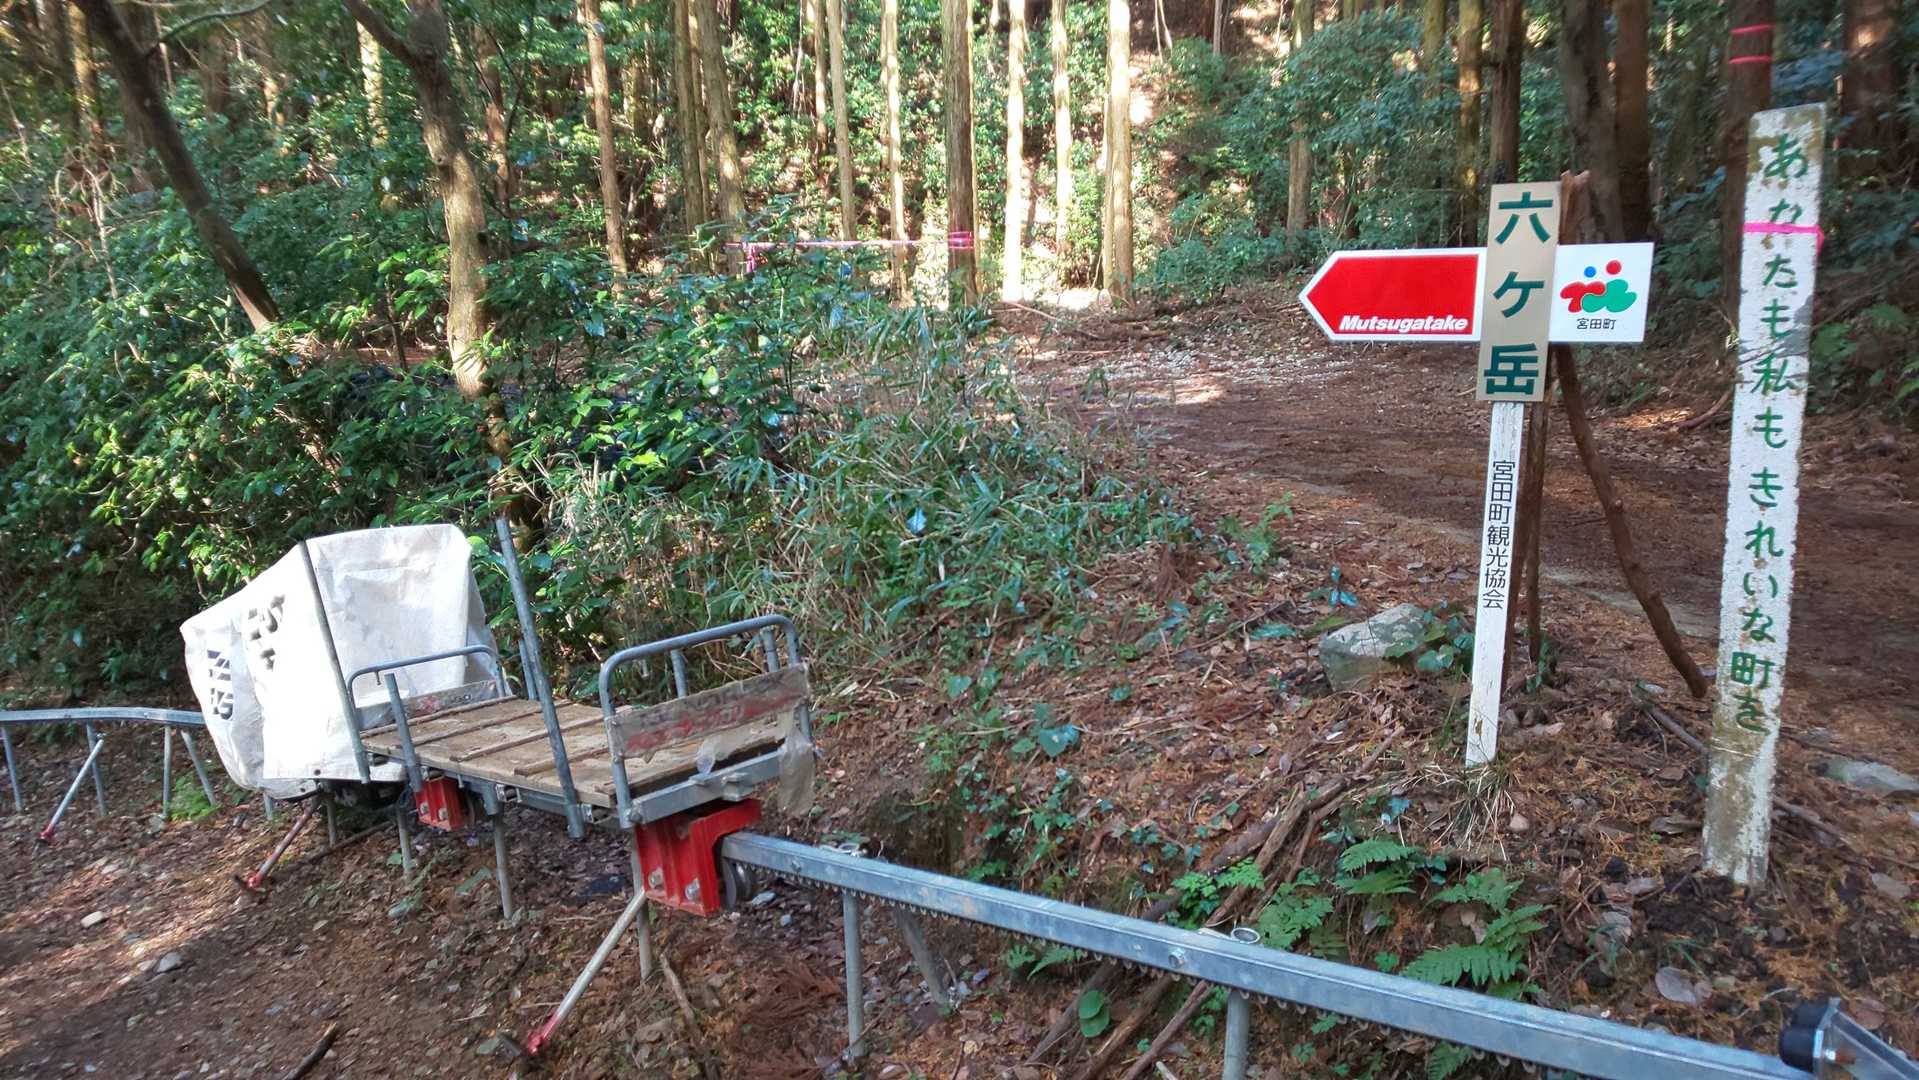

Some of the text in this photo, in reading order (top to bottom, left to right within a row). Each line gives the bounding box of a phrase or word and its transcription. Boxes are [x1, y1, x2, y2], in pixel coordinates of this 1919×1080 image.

[1339, 314, 1468, 333] Mutsugatake
[1576, 317, 1617, 330] 宮田町
[1482, 460, 1516, 610] 宮田町観光協会
